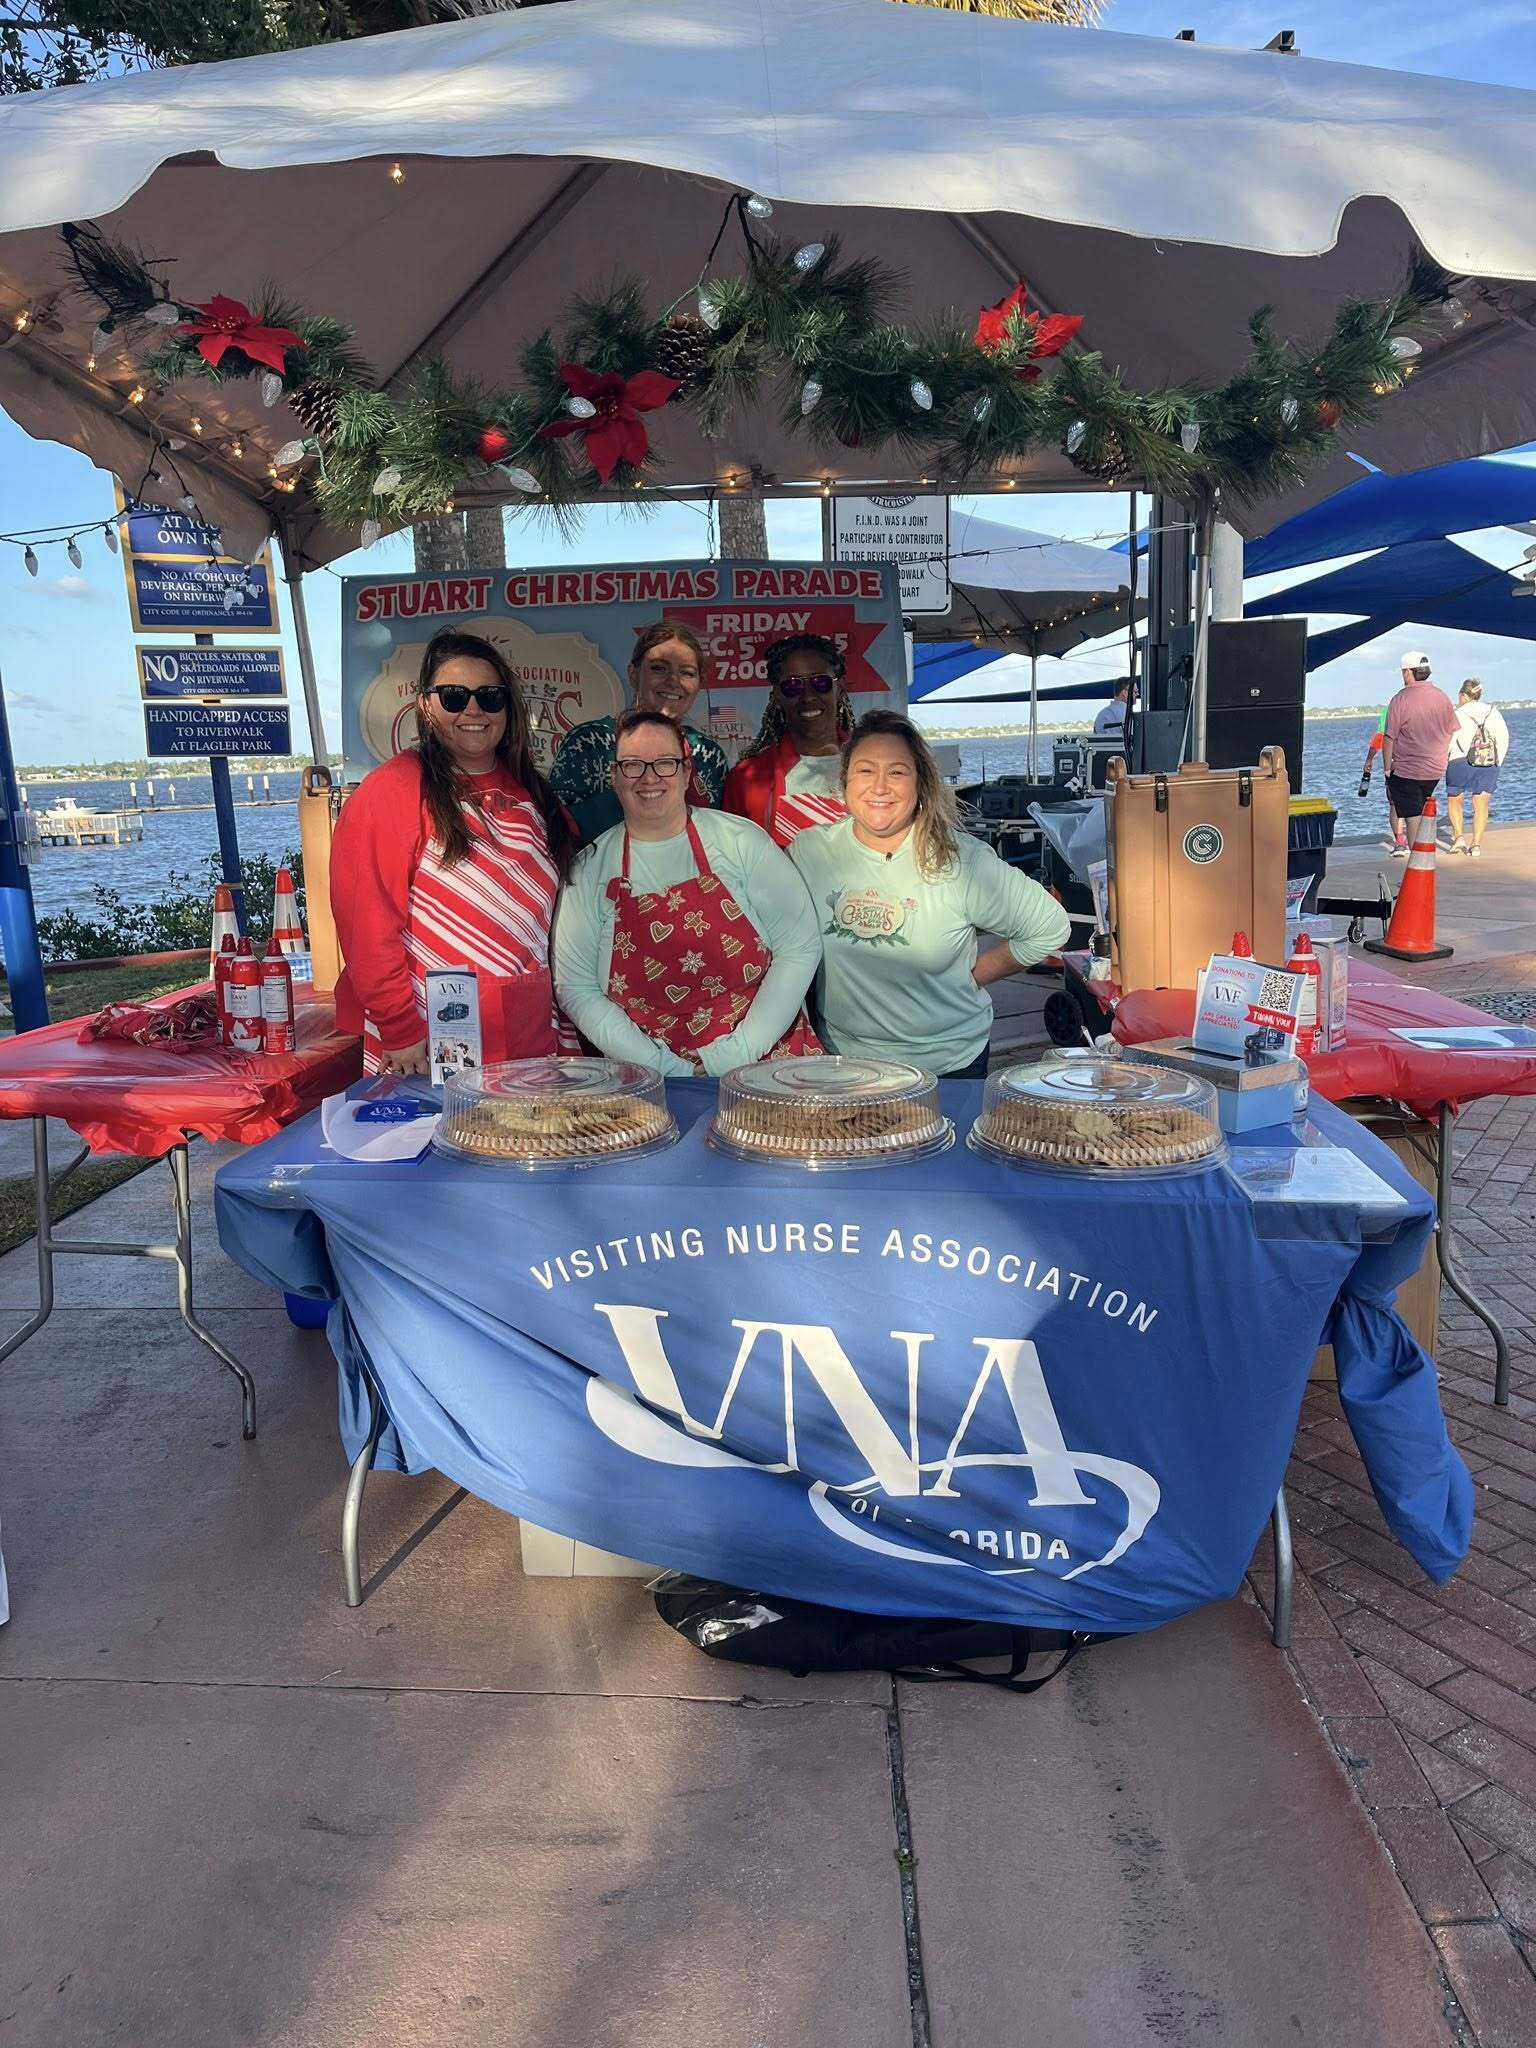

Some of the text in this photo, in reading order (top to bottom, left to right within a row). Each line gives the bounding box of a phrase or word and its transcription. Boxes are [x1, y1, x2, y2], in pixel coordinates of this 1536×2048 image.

[161, 515, 183, 528] AT
[855, 515, 929, 526] F.I.N.D. WAS A JOINT
[157, 530, 198, 544] OWN
[840, 533, 944, 545] PARTICIPANT & CONTRIBUTOR
[840, 551, 849, 560] TO
[852, 551, 865, 561] THE
[866, 551, 917, 561] DEVELOPMENT
[161, 571, 178, 581] NO
[901, 569, 925, 580] DWALK
[141, 580, 203, 592] BEVERAGES
[163, 592, 224, 602] ON RIVERW
[356, 568, 884, 622] STUART CHRISTMAS PARADE
[143, 608, 159, 616] CITY
[160, 608, 180, 616] CODE
[705, 612, 813, 634] FRIDAY
[699, 636, 735, 657] EC.
[221, 653, 253, 663] SKATES,
[254, 653, 267, 662] OR
[142, 655, 179, 682] NO
[180, 663, 280, 673] SKATEBOARDS ALLOWED
[181, 676, 246, 685] ON RIVERWALK
[148, 710, 288, 723] HANDICAPPED ACCESS
[175, 727, 264, 737] TO RIVERWALK
[170, 741, 272, 752] AT FLAGLER PARK
[528, 1222, 1159, 1334] VISITING NURSE ASSOCIATION
[592, 1301, 1098, 1506] VNA
